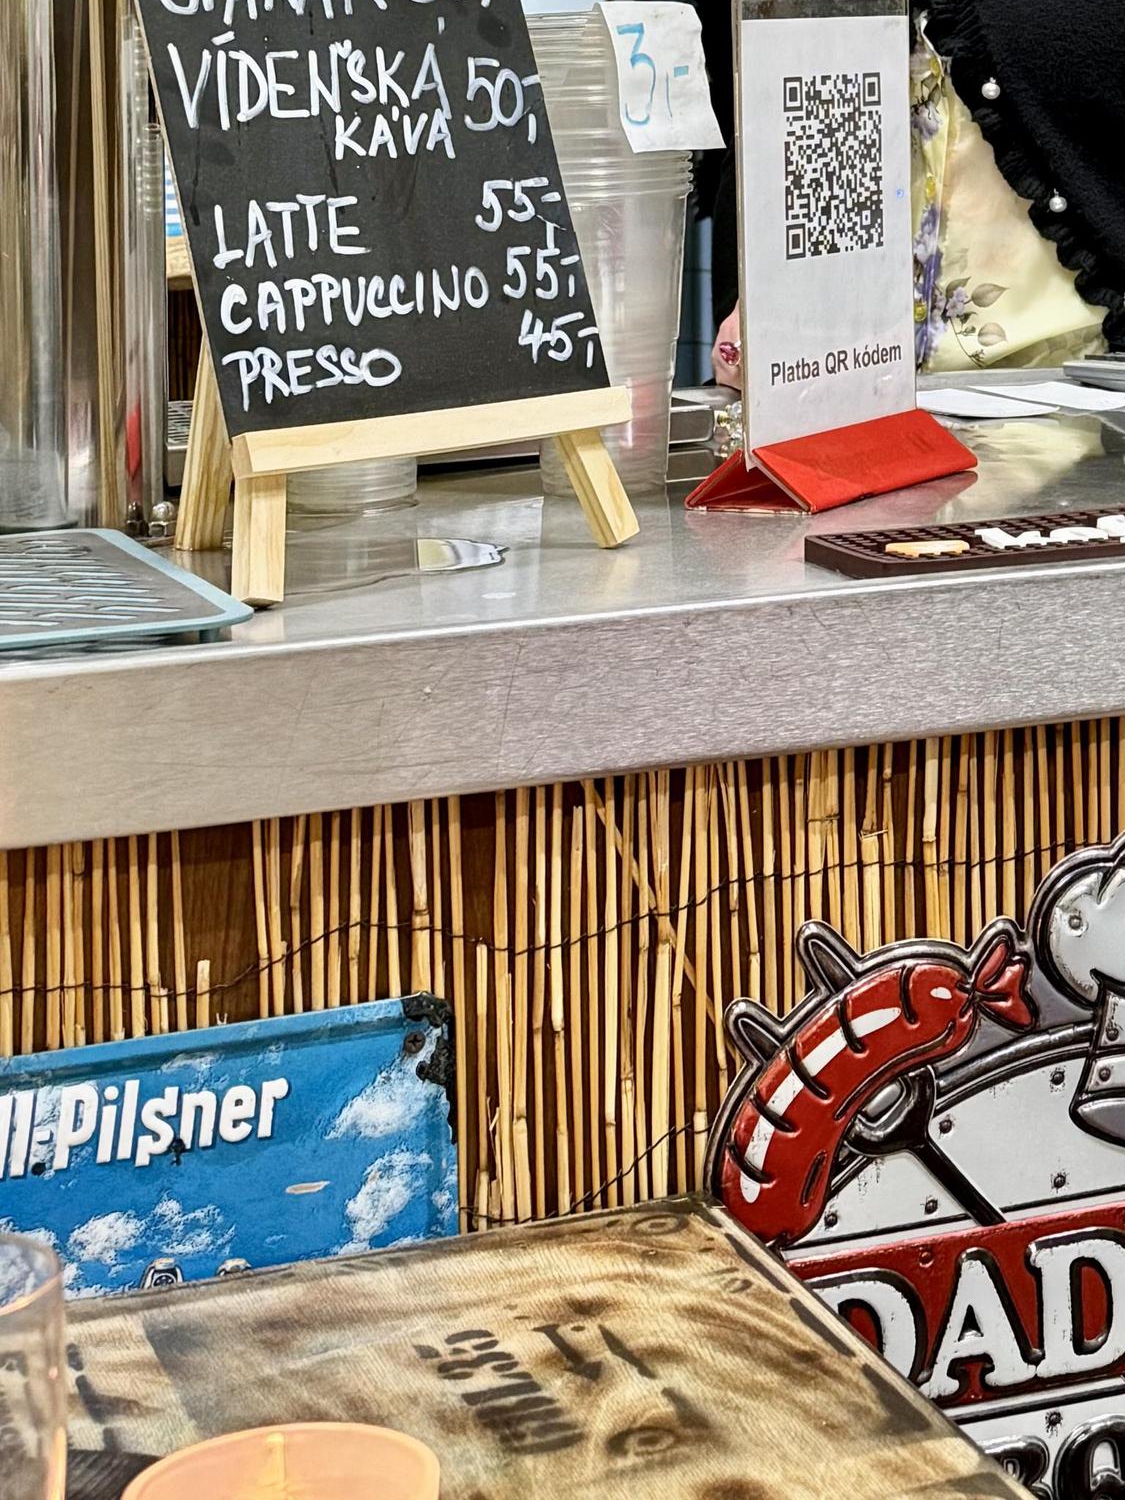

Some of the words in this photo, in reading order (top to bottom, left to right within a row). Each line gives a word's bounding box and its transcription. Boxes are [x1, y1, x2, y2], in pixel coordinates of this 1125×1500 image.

[334, 107, 455, 160] KÁVA
[465, 57, 540, 143] 50,-
[214, 195, 371, 269] LATTE
[220, 265, 488, 335] CAPPUCCINO
[503, 247, 579, 299] 55,-
[222, 345, 401, 412] PRESSO
[518, 310, 598, 368] 45,-
[770, 360, 821, 386] Platba
[825, 353, 849, 378] QR
[853, 343, 902, 369] kódem
